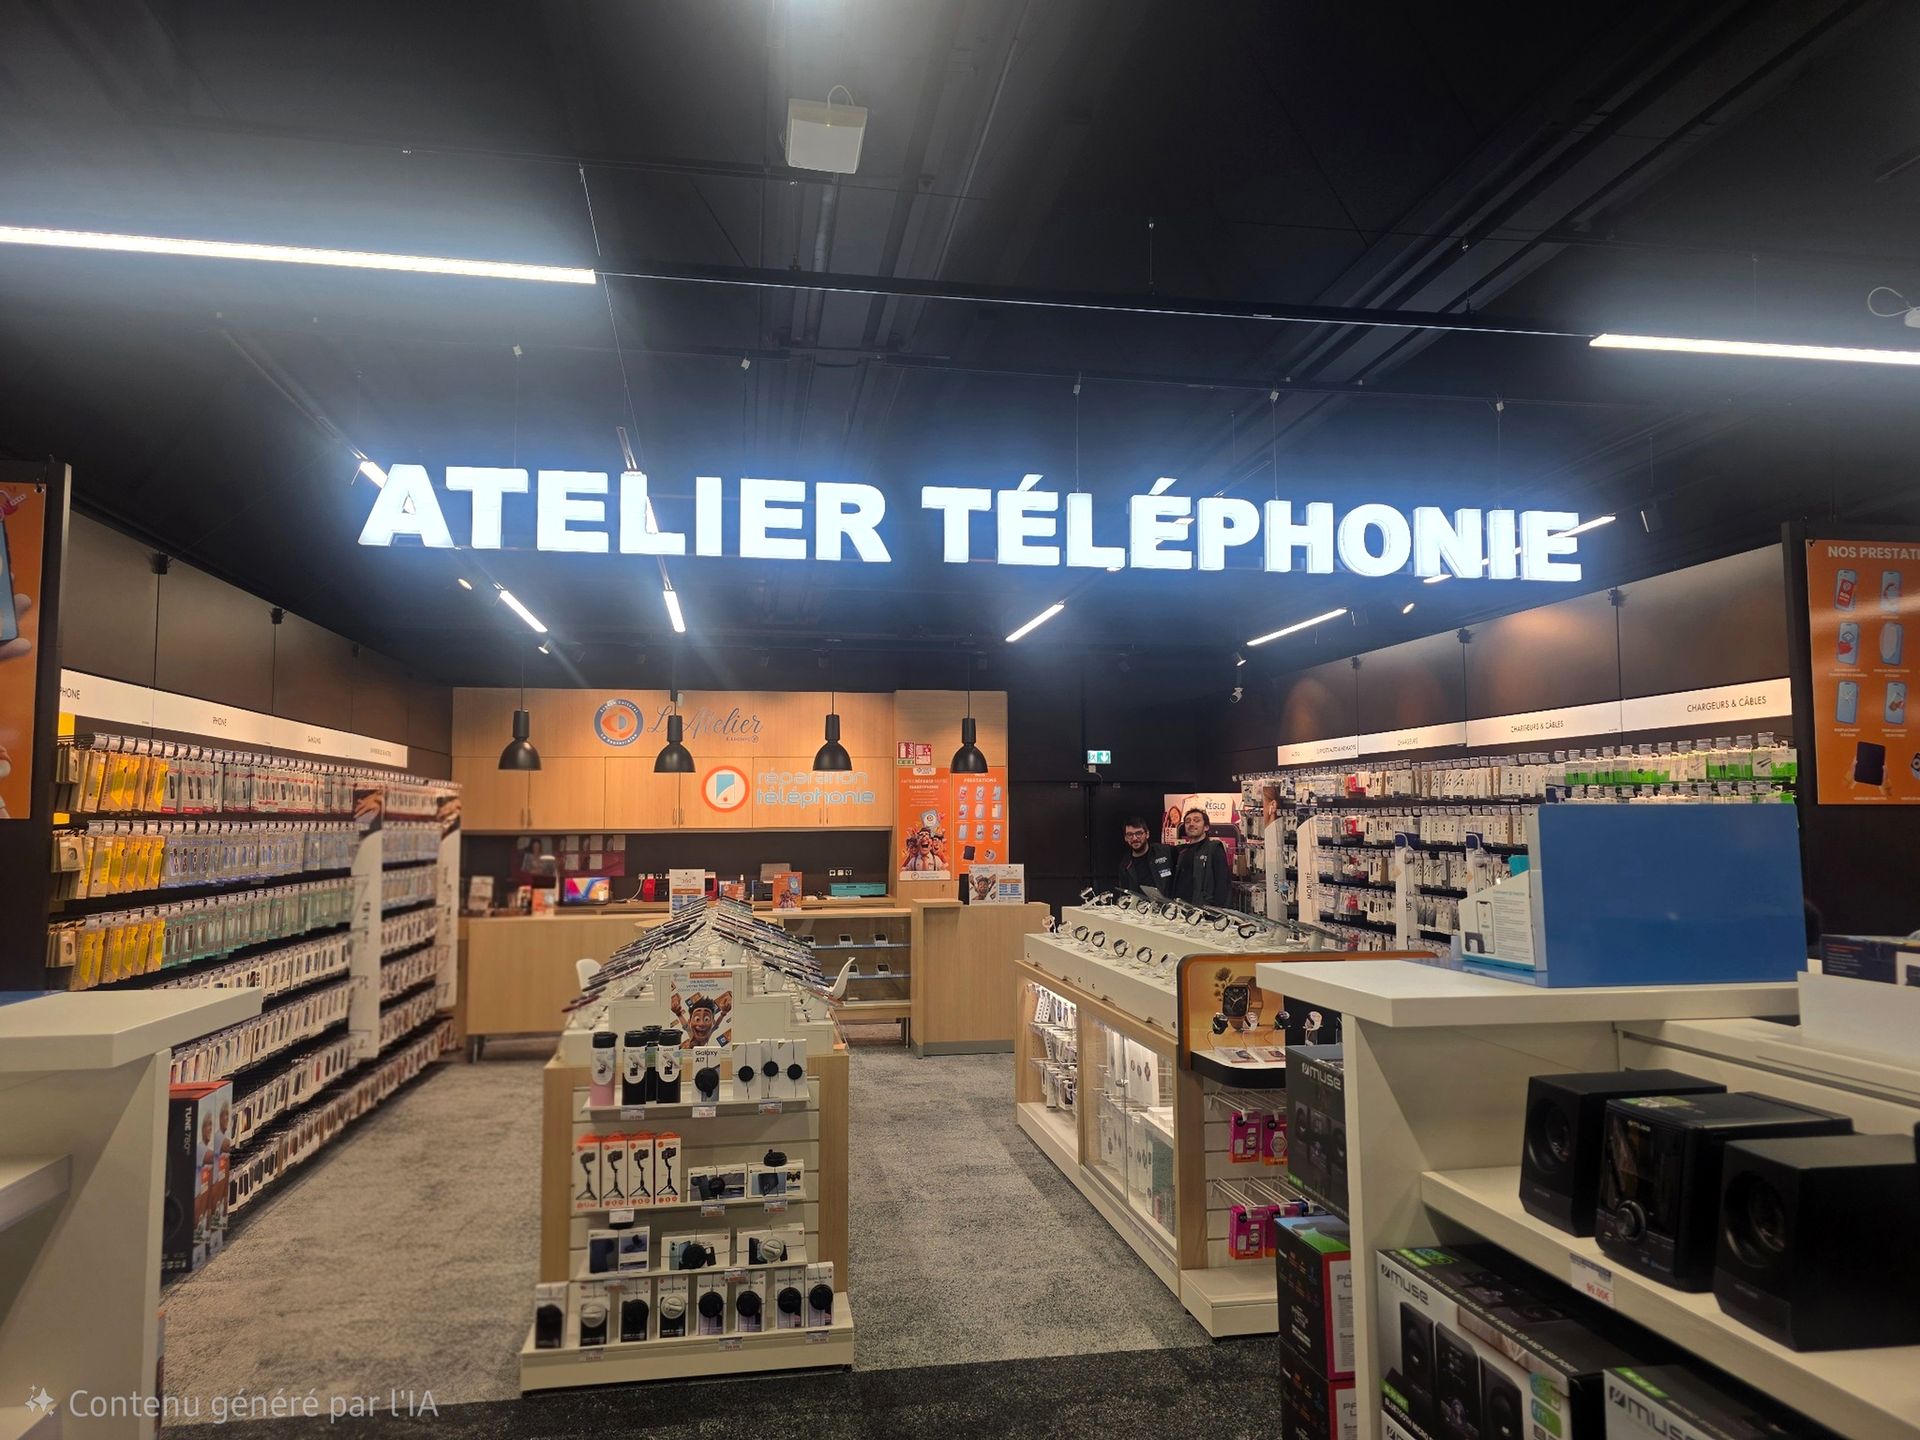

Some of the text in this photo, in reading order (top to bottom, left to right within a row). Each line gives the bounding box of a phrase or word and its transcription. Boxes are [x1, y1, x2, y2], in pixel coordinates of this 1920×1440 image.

[358, 463, 1582, 582] ATELIER TÉLÉPHONIE
[1828, 546, 1857, 558] NOS
[1687, 695, 1767, 713] CHARGEURS & CÂBLES
[757, 768, 868, 788] réparation
[756, 785, 876, 809] téléphonie
[1305, 872, 1313, 900] MOBILITÉ
[1310, 1067, 1342, 1091] muse
[184, 1106, 192, 1131] TUNE
[1390, 1270, 1429, 1306] muse
[1526, 1340, 1544, 1350] AND
[1541, 1349, 1559, 1360] USB
[1555, 1359, 1579, 1373] PORT
[1628, 1396, 1697, 1440] mus
